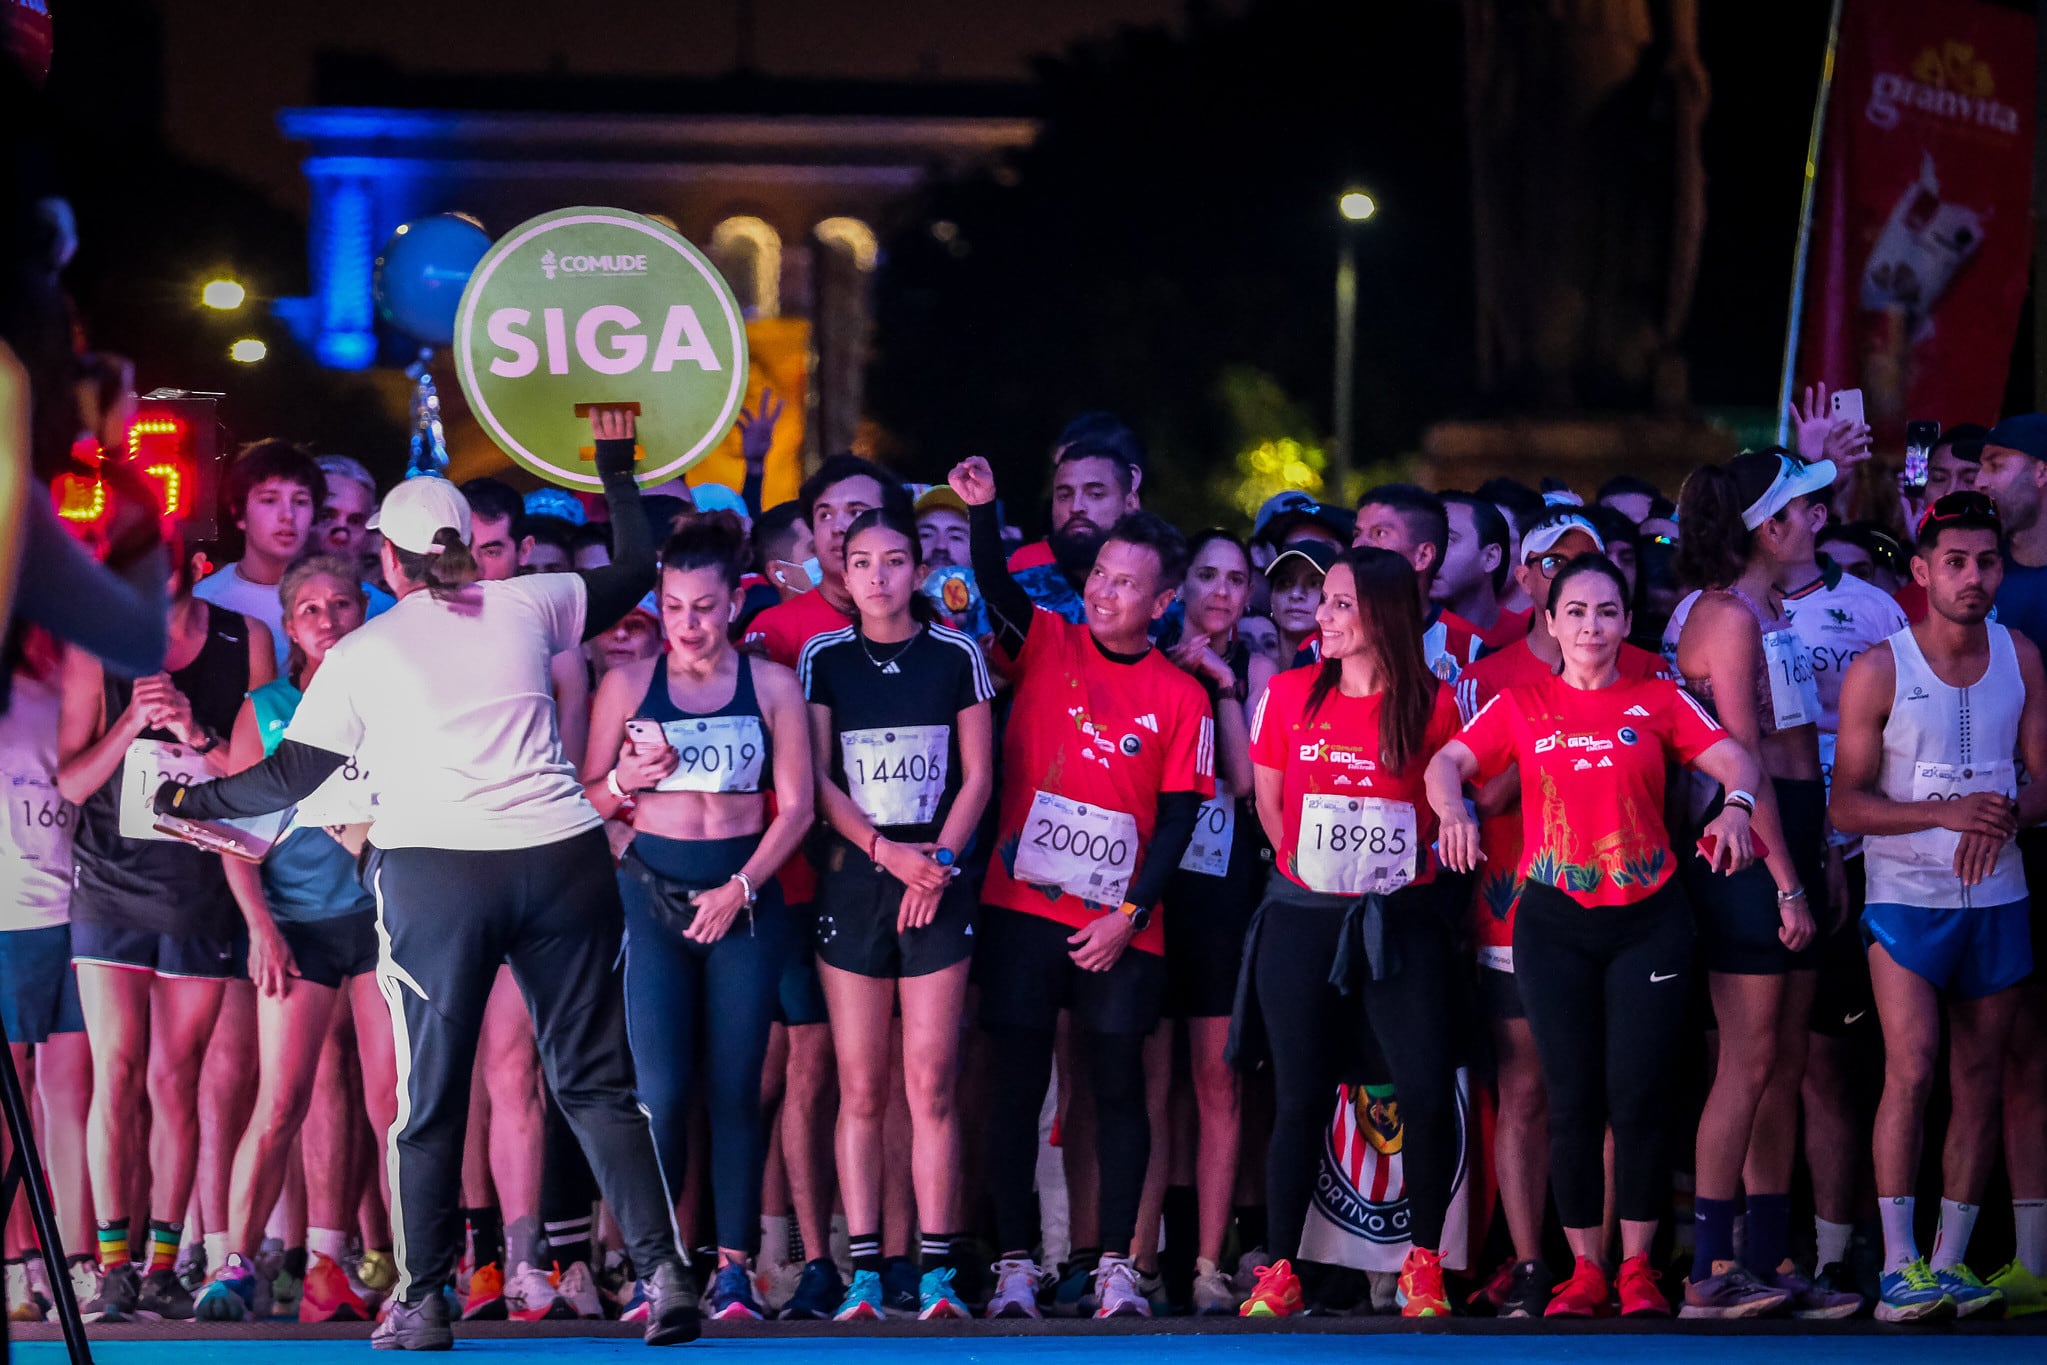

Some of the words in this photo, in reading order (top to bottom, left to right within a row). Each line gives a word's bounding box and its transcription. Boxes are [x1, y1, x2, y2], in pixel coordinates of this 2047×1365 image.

[560, 254, 648, 273] COMUDE
[487, 304, 722, 378] SIGA
[682, 743, 756, 773] 9019
[856, 754, 940, 785] 14406
[23, 800, 67, 827] 166
[1033, 819, 1127, 866] 20000
[1315, 824, 1406, 855] 18985
[1392, 1208, 1412, 1230] G
